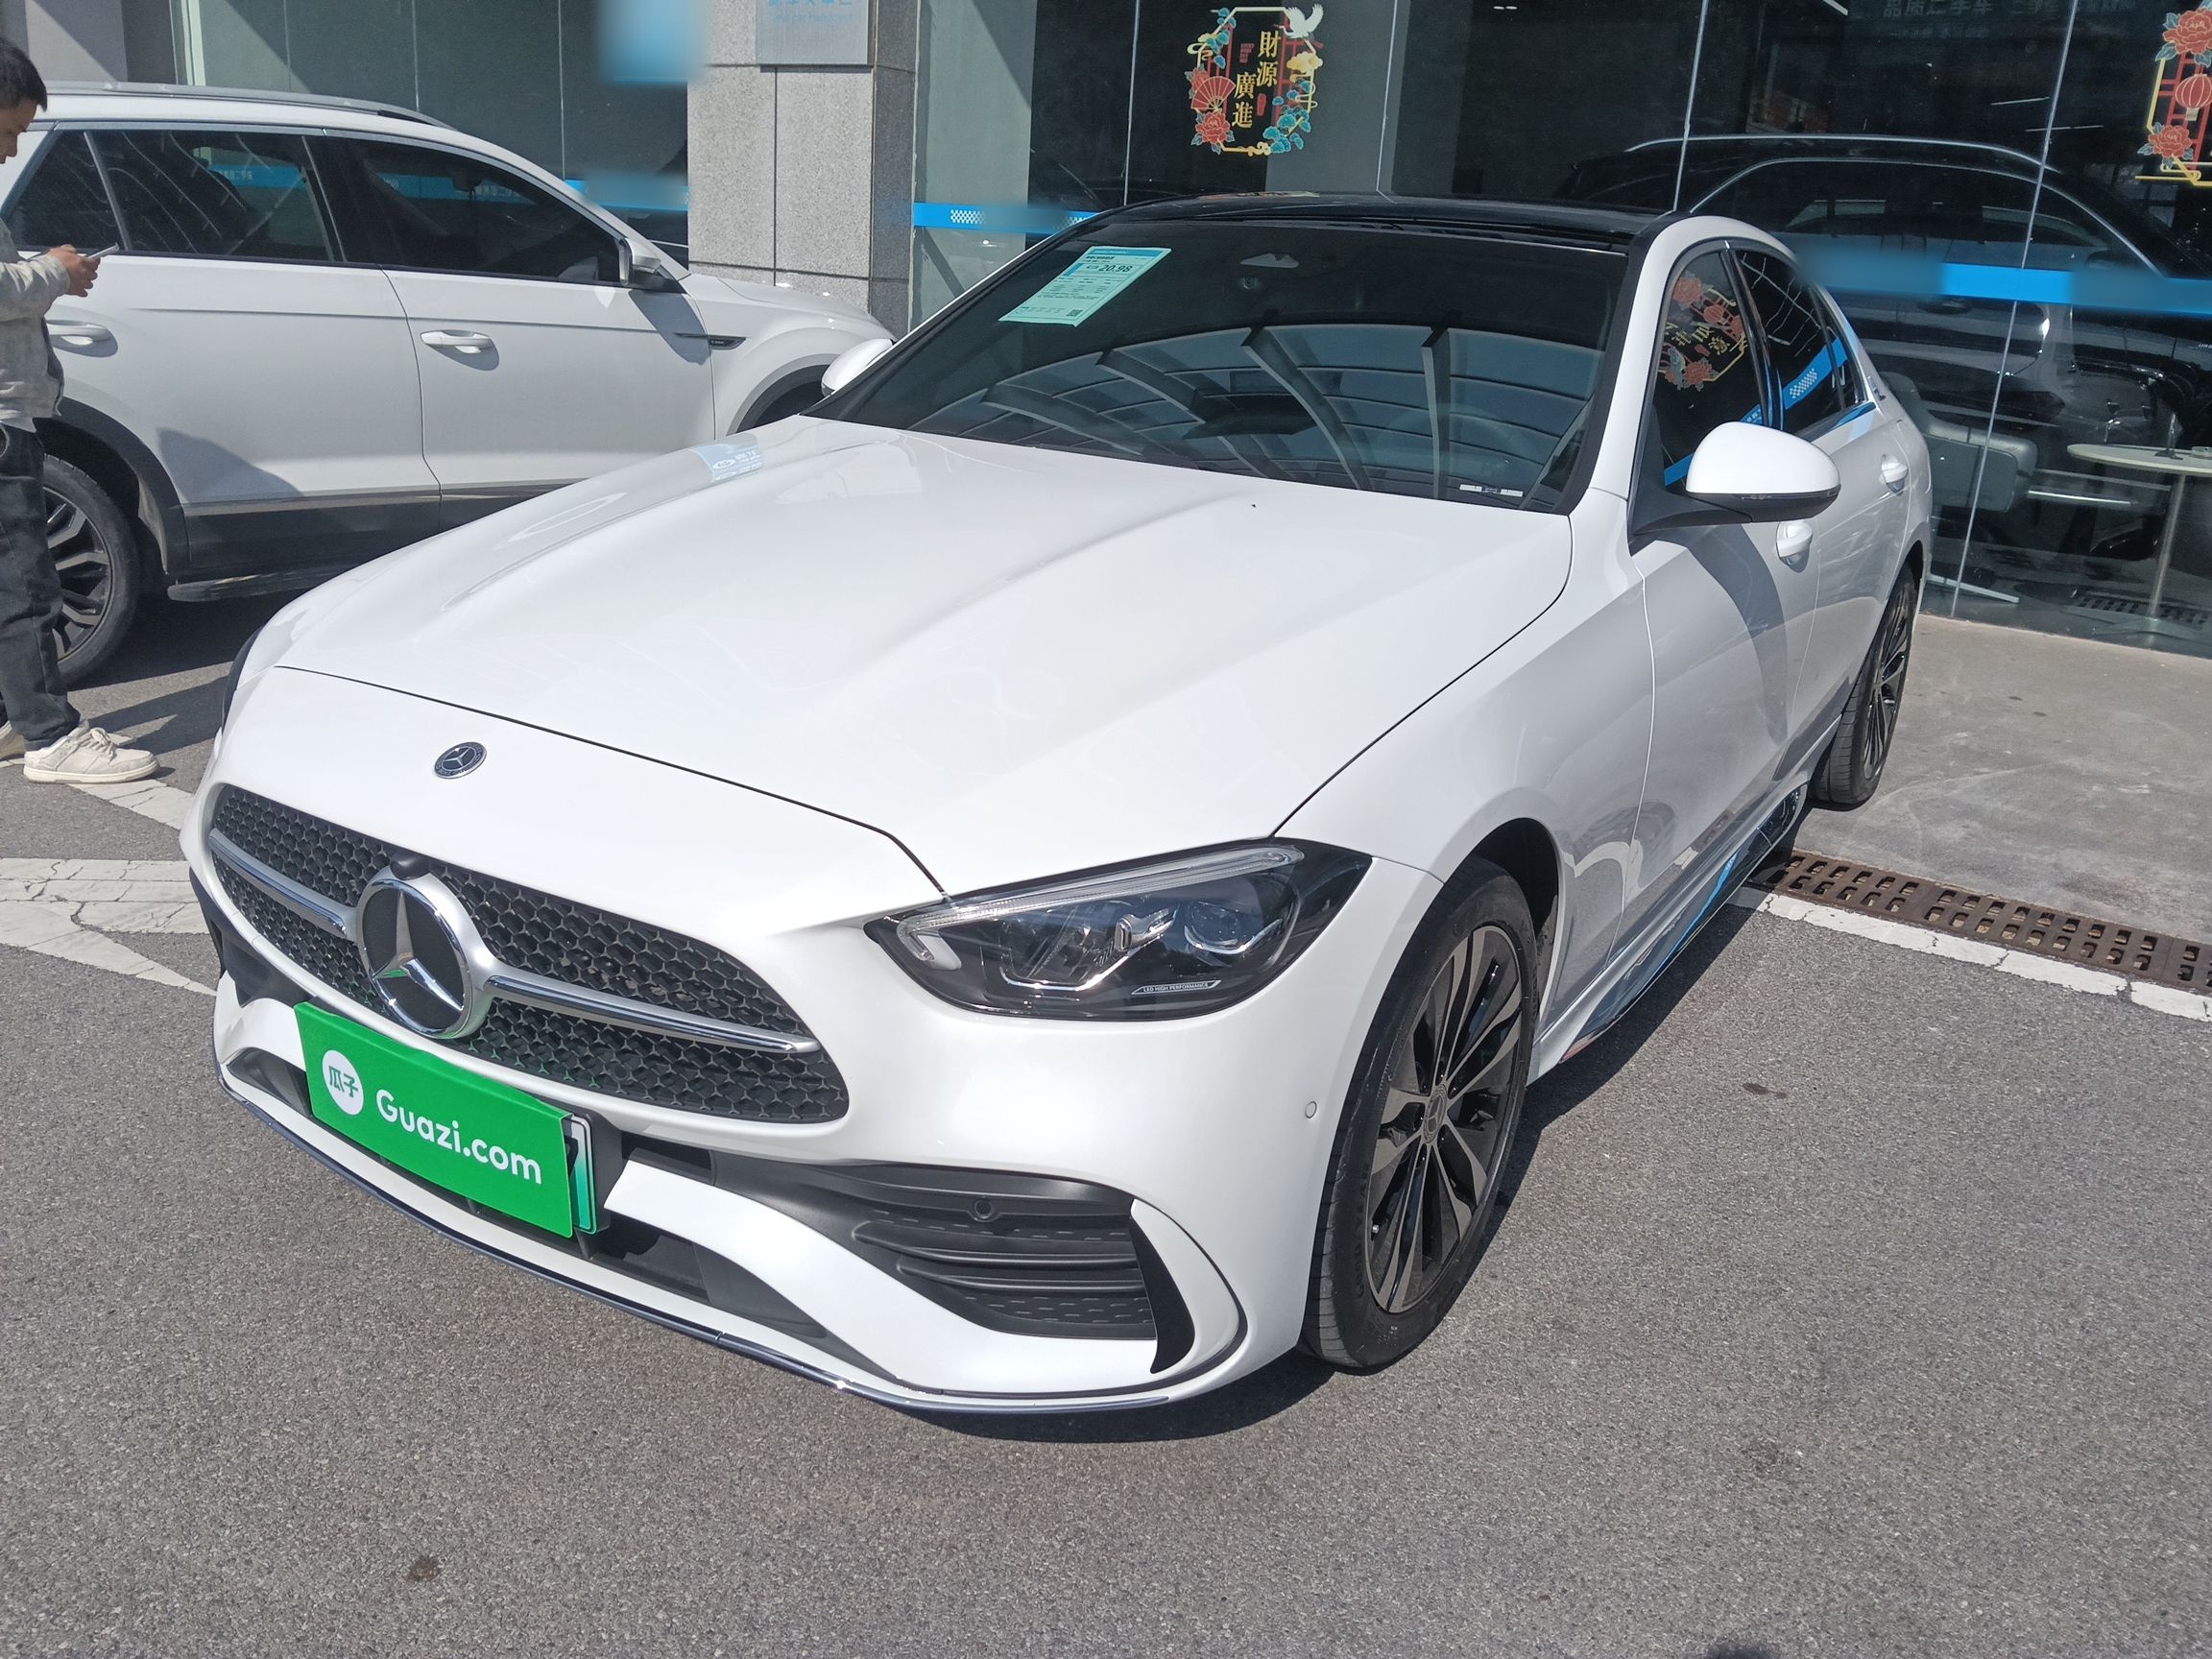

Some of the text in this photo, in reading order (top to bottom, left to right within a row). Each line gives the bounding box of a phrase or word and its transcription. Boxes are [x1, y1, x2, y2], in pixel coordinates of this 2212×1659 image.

[1257, 31, 1281, 86] 財源
[1232, 72, 1257, 129] 廣進
[1098, 264, 1133, 273] 20.98
[328, 1065, 359, 1098] 瓜子
[375, 1089, 542, 1185] Guazi.com
